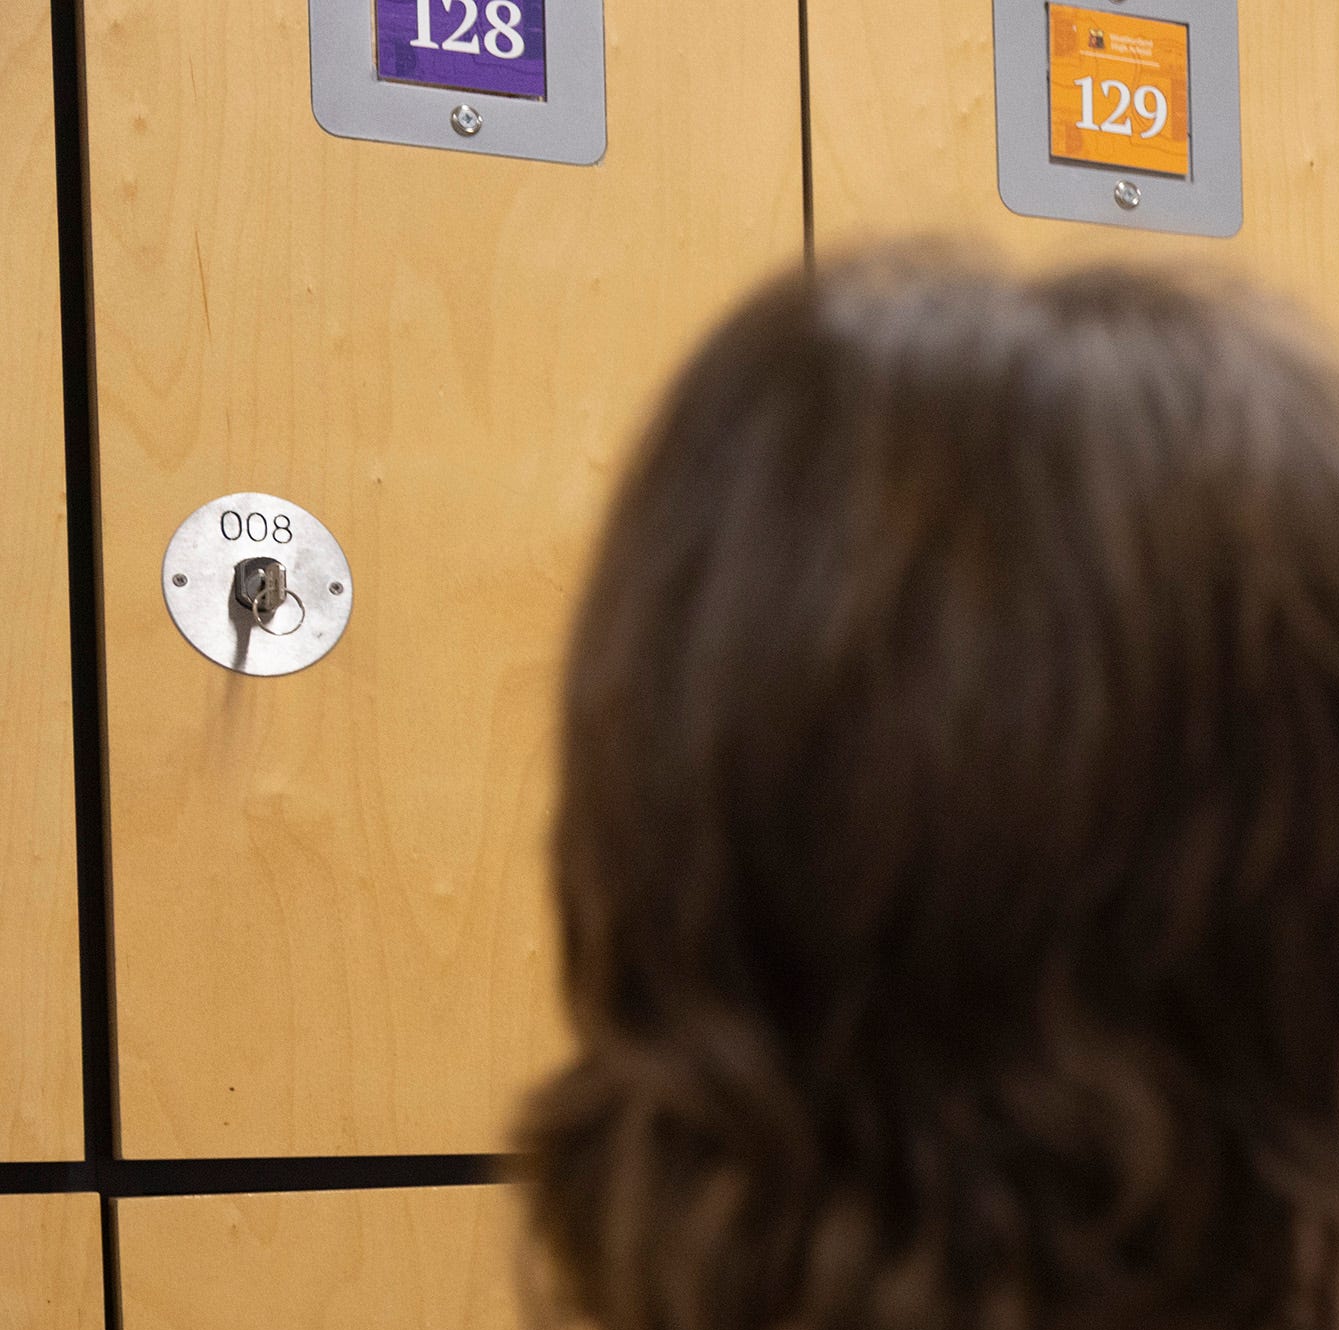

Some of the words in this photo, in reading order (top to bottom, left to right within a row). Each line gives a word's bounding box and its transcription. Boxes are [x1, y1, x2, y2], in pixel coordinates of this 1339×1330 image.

[410, 0, 525, 59] 128
[1074, 76, 1168, 139] 129
[220, 510, 293, 544] 008
